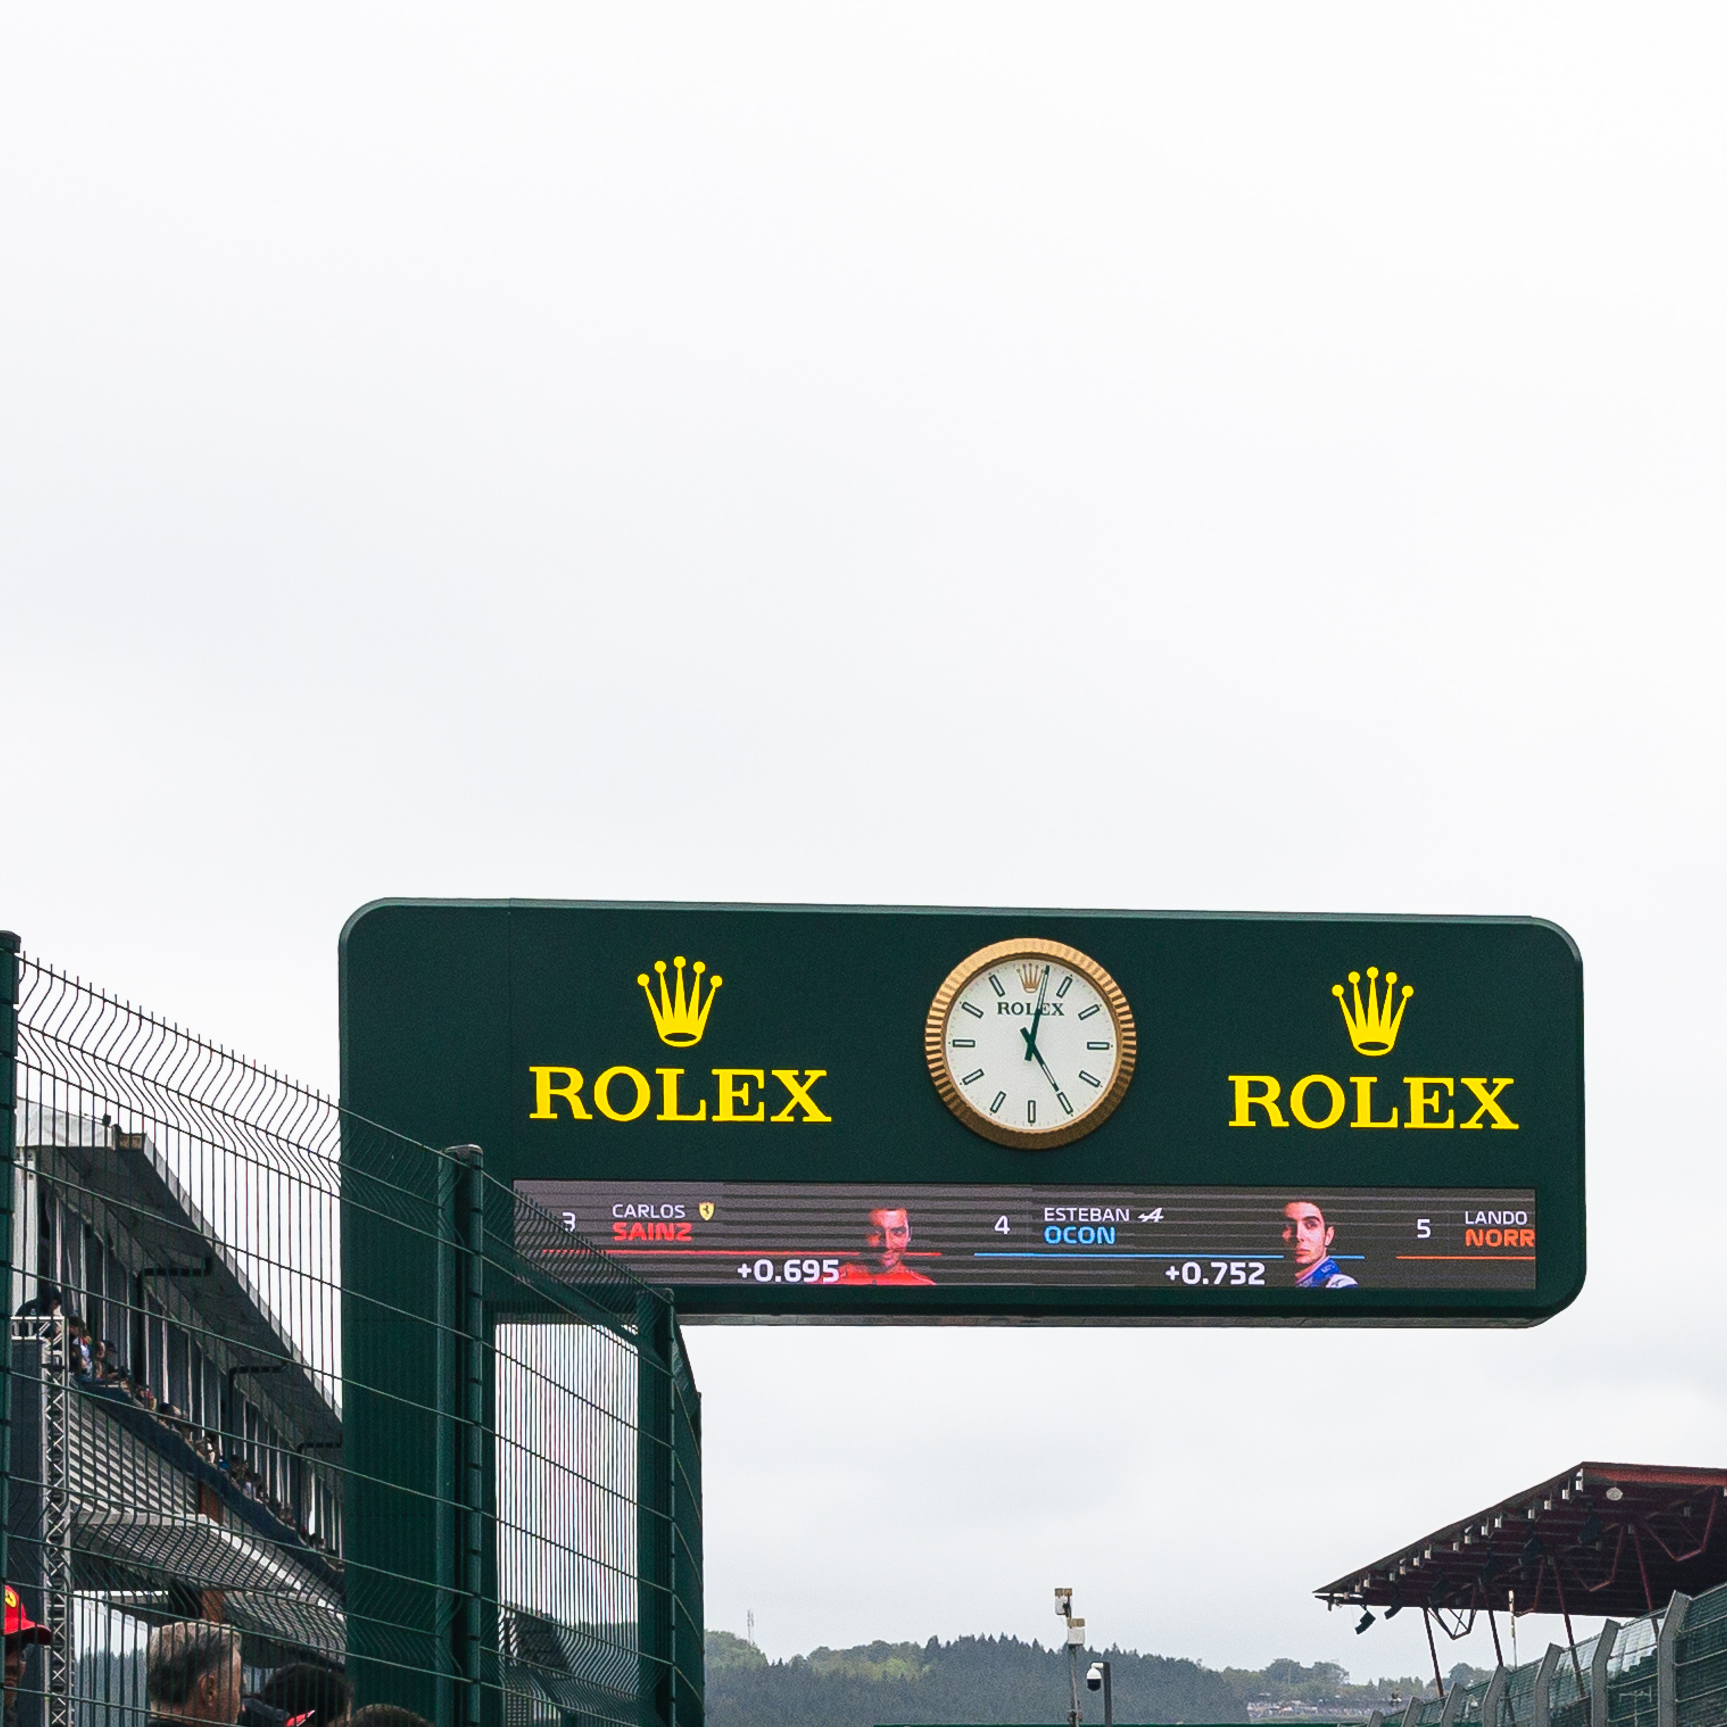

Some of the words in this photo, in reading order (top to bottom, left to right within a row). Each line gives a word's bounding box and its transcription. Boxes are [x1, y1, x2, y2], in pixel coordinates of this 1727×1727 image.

[997, 1002, 1064, 1017] ROLEX
[529, 1066, 832, 1123] ROLEX
[1228, 1075, 1520, 1130] ROLEX
[612, 1203, 686, 1219] CARLOS
[1044, 1207, 1130, 1223] ESTEBAN
[1465, 1211, 1528, 1226] LANDO
[562, 1211, 576, 1233] 3
[612, 1222, 693, 1243] SAINZ
[994, 1215, 1011, 1235] 4
[1416, 1218, 1431, 1239] 5
[1044, 1225, 1116, 1245] OCON
[737, 1258, 840, 1284] +0.695
[1165, 1261, 1266, 1285] +0.752
